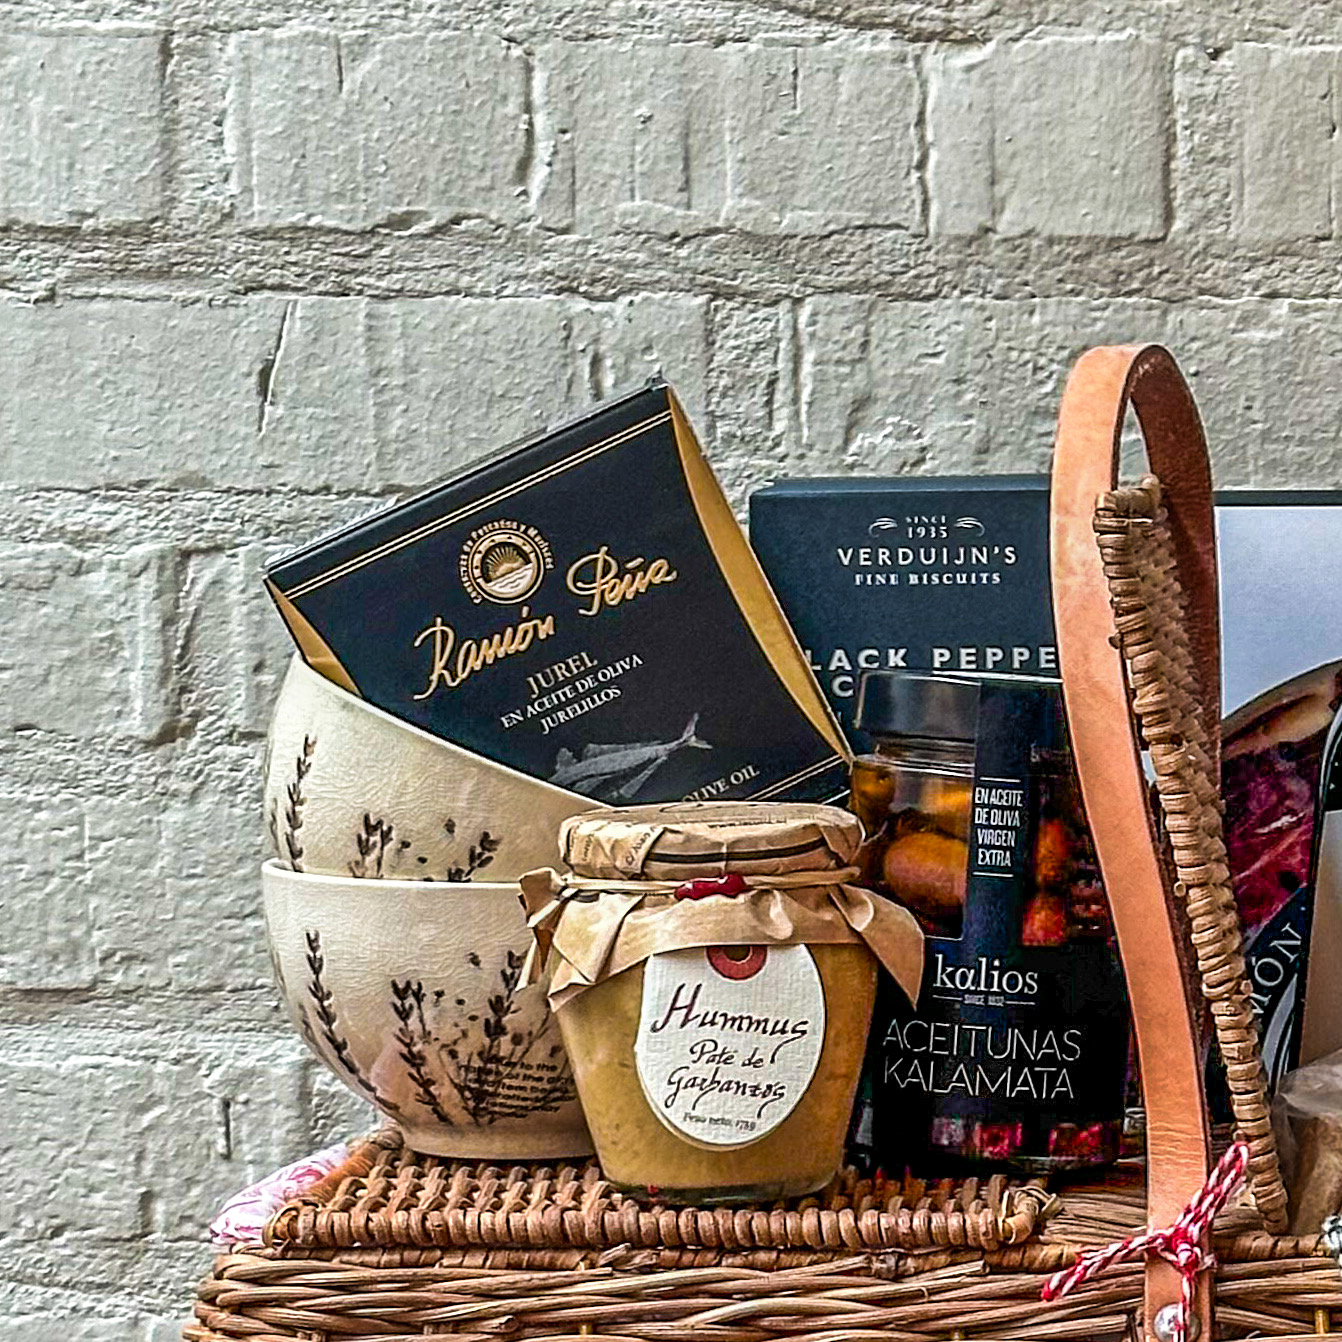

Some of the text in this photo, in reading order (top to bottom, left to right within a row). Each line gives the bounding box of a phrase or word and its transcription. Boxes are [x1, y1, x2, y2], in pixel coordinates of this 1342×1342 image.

[907, 526, 948, 538] 1935
[837, 547, 1017, 566] VERDUIJN'S
[855, 572, 1001, 586] FINE BISCUITS
[413, 546, 677, 700] Ramón Peña
[807, 647, 1056, 670] LACK PEPPE
[526, 652, 598, 698] JUREL
[501, 654, 644, 728] EN ACEITE DE OLIVA
[730, 765, 760, 784] OIL
[975, 787, 1024, 807] EN ACEITE
[974, 808, 1021, 827] DE OLIVA
[977, 828, 1016, 847] VIRGEN
[977, 848, 1012, 867] EXTRA
[932, 954, 1038, 995] kalios
[650, 983, 809, 1063] Hummus
[883, 1018, 1082, 1062] ACEITUNAS
[741, 1048, 764, 1069] de
[884, 1056, 1075, 1100] KALAMATA
